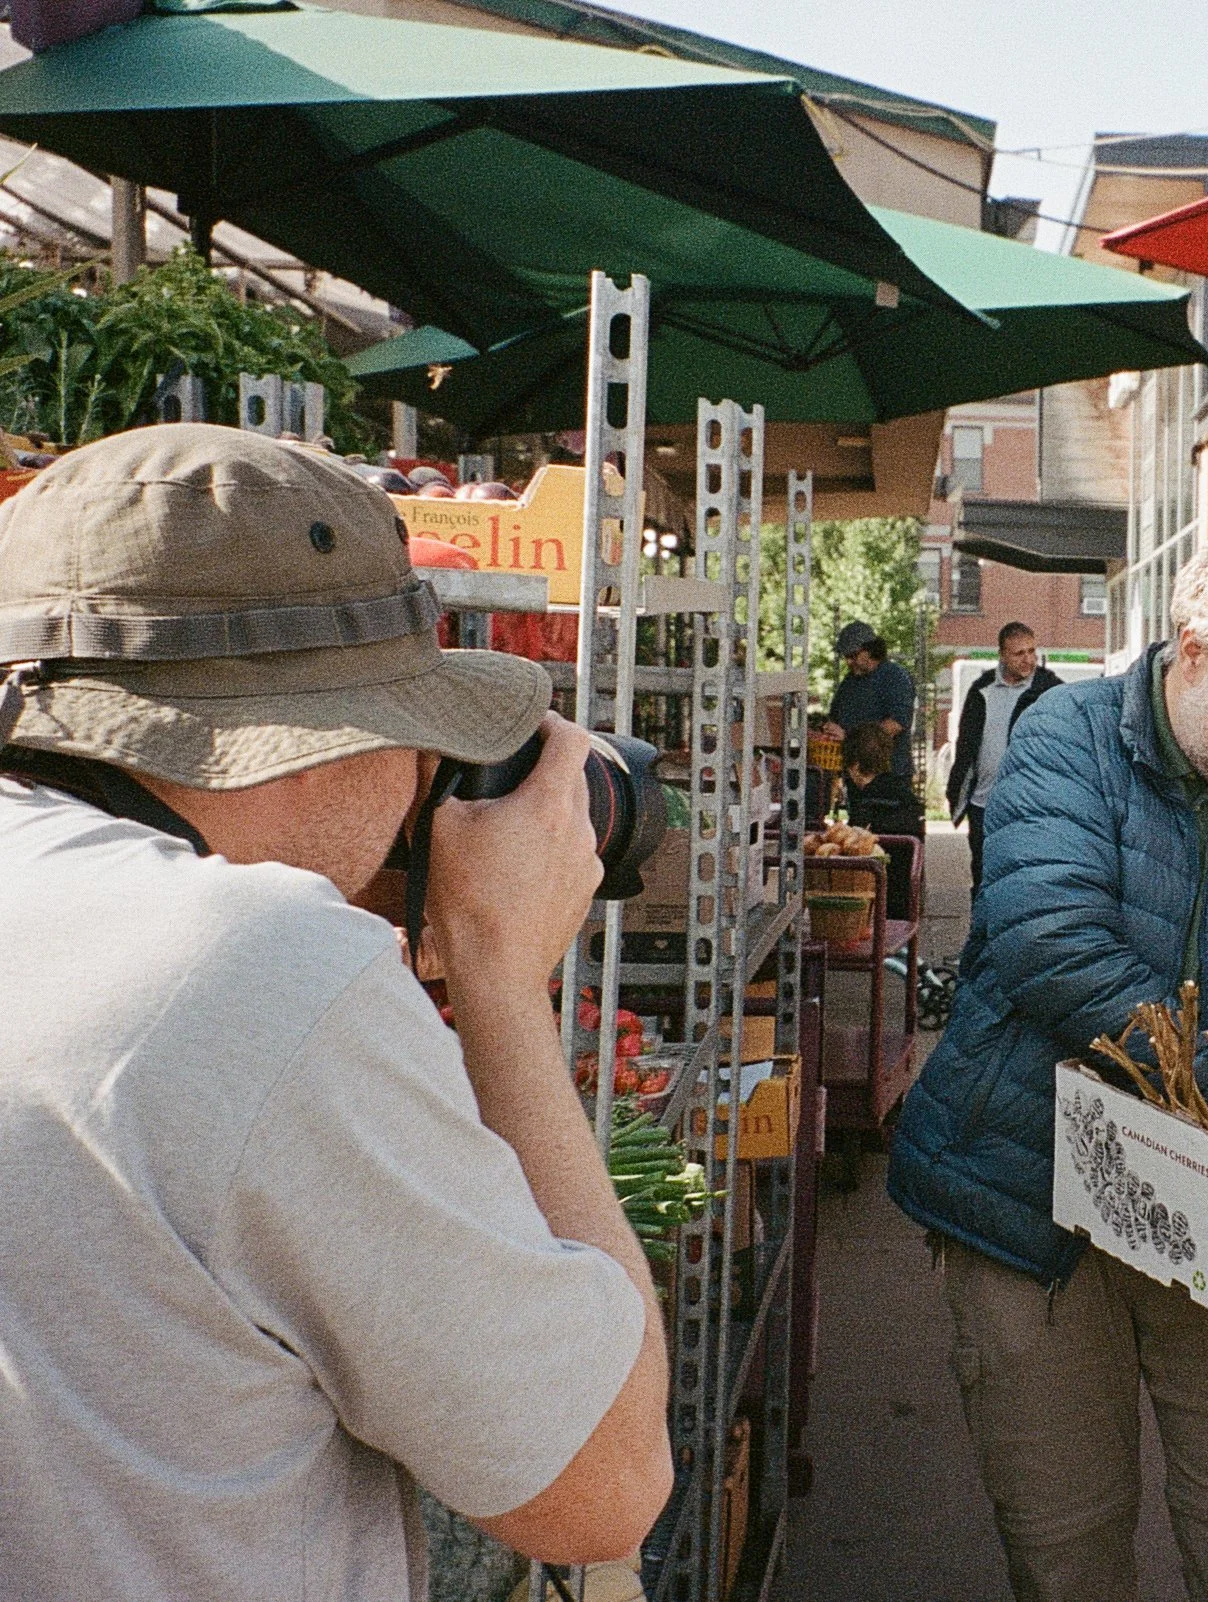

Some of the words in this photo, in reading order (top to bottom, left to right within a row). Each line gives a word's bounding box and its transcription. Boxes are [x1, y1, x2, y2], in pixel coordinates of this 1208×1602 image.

[411, 506, 480, 529] François
[415, 514, 568, 571] elin
[1121, 1125, 1168, 1157] CANADIAN
